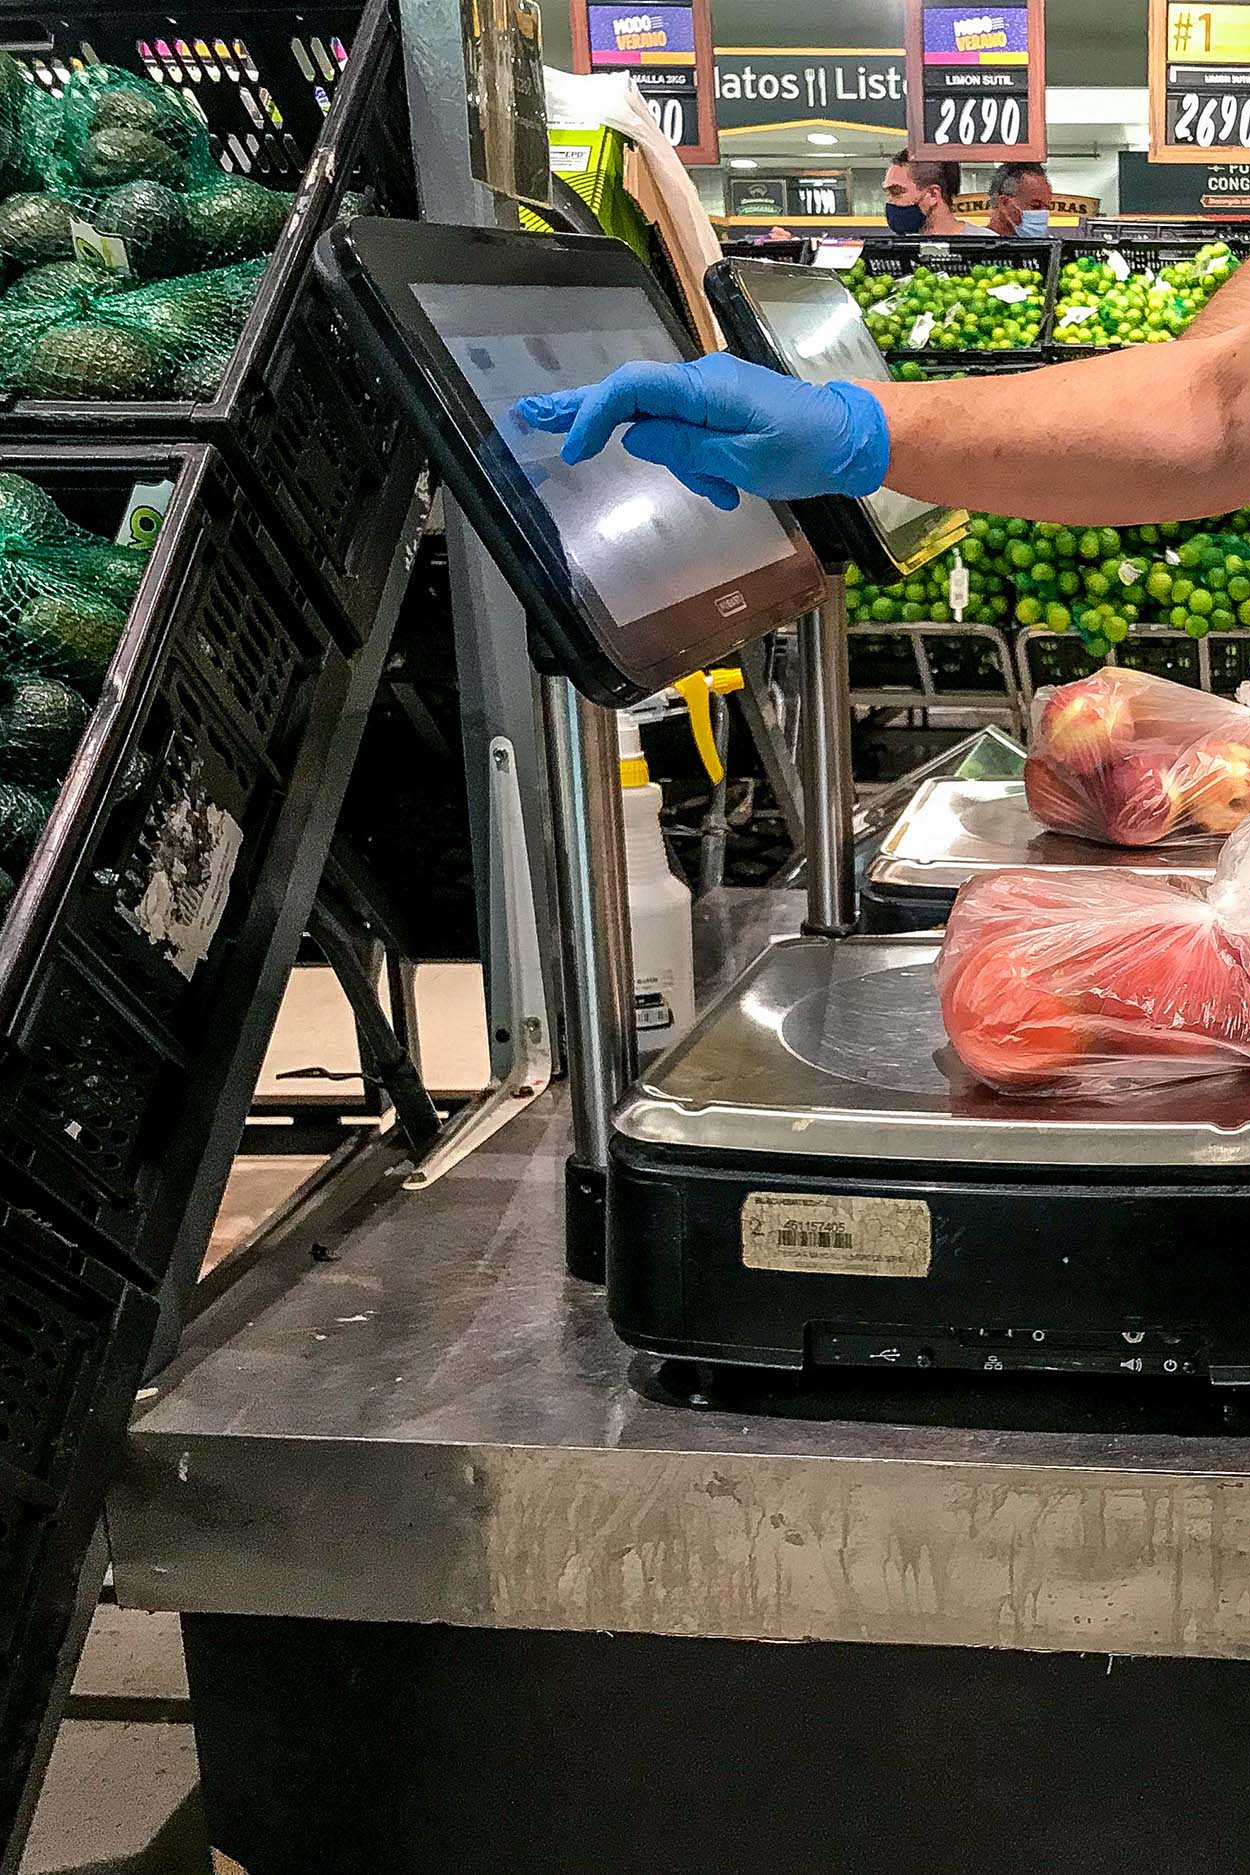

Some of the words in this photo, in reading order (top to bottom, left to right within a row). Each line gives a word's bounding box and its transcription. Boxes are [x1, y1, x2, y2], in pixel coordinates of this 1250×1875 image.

[1174, 13, 1211, 51] #1
[835, 67, 908, 100] List
[945, 75, 980, 85] LIMON
[982, 75, 1014, 86] SUTIL
[935, 98, 1020, 145] 2690
